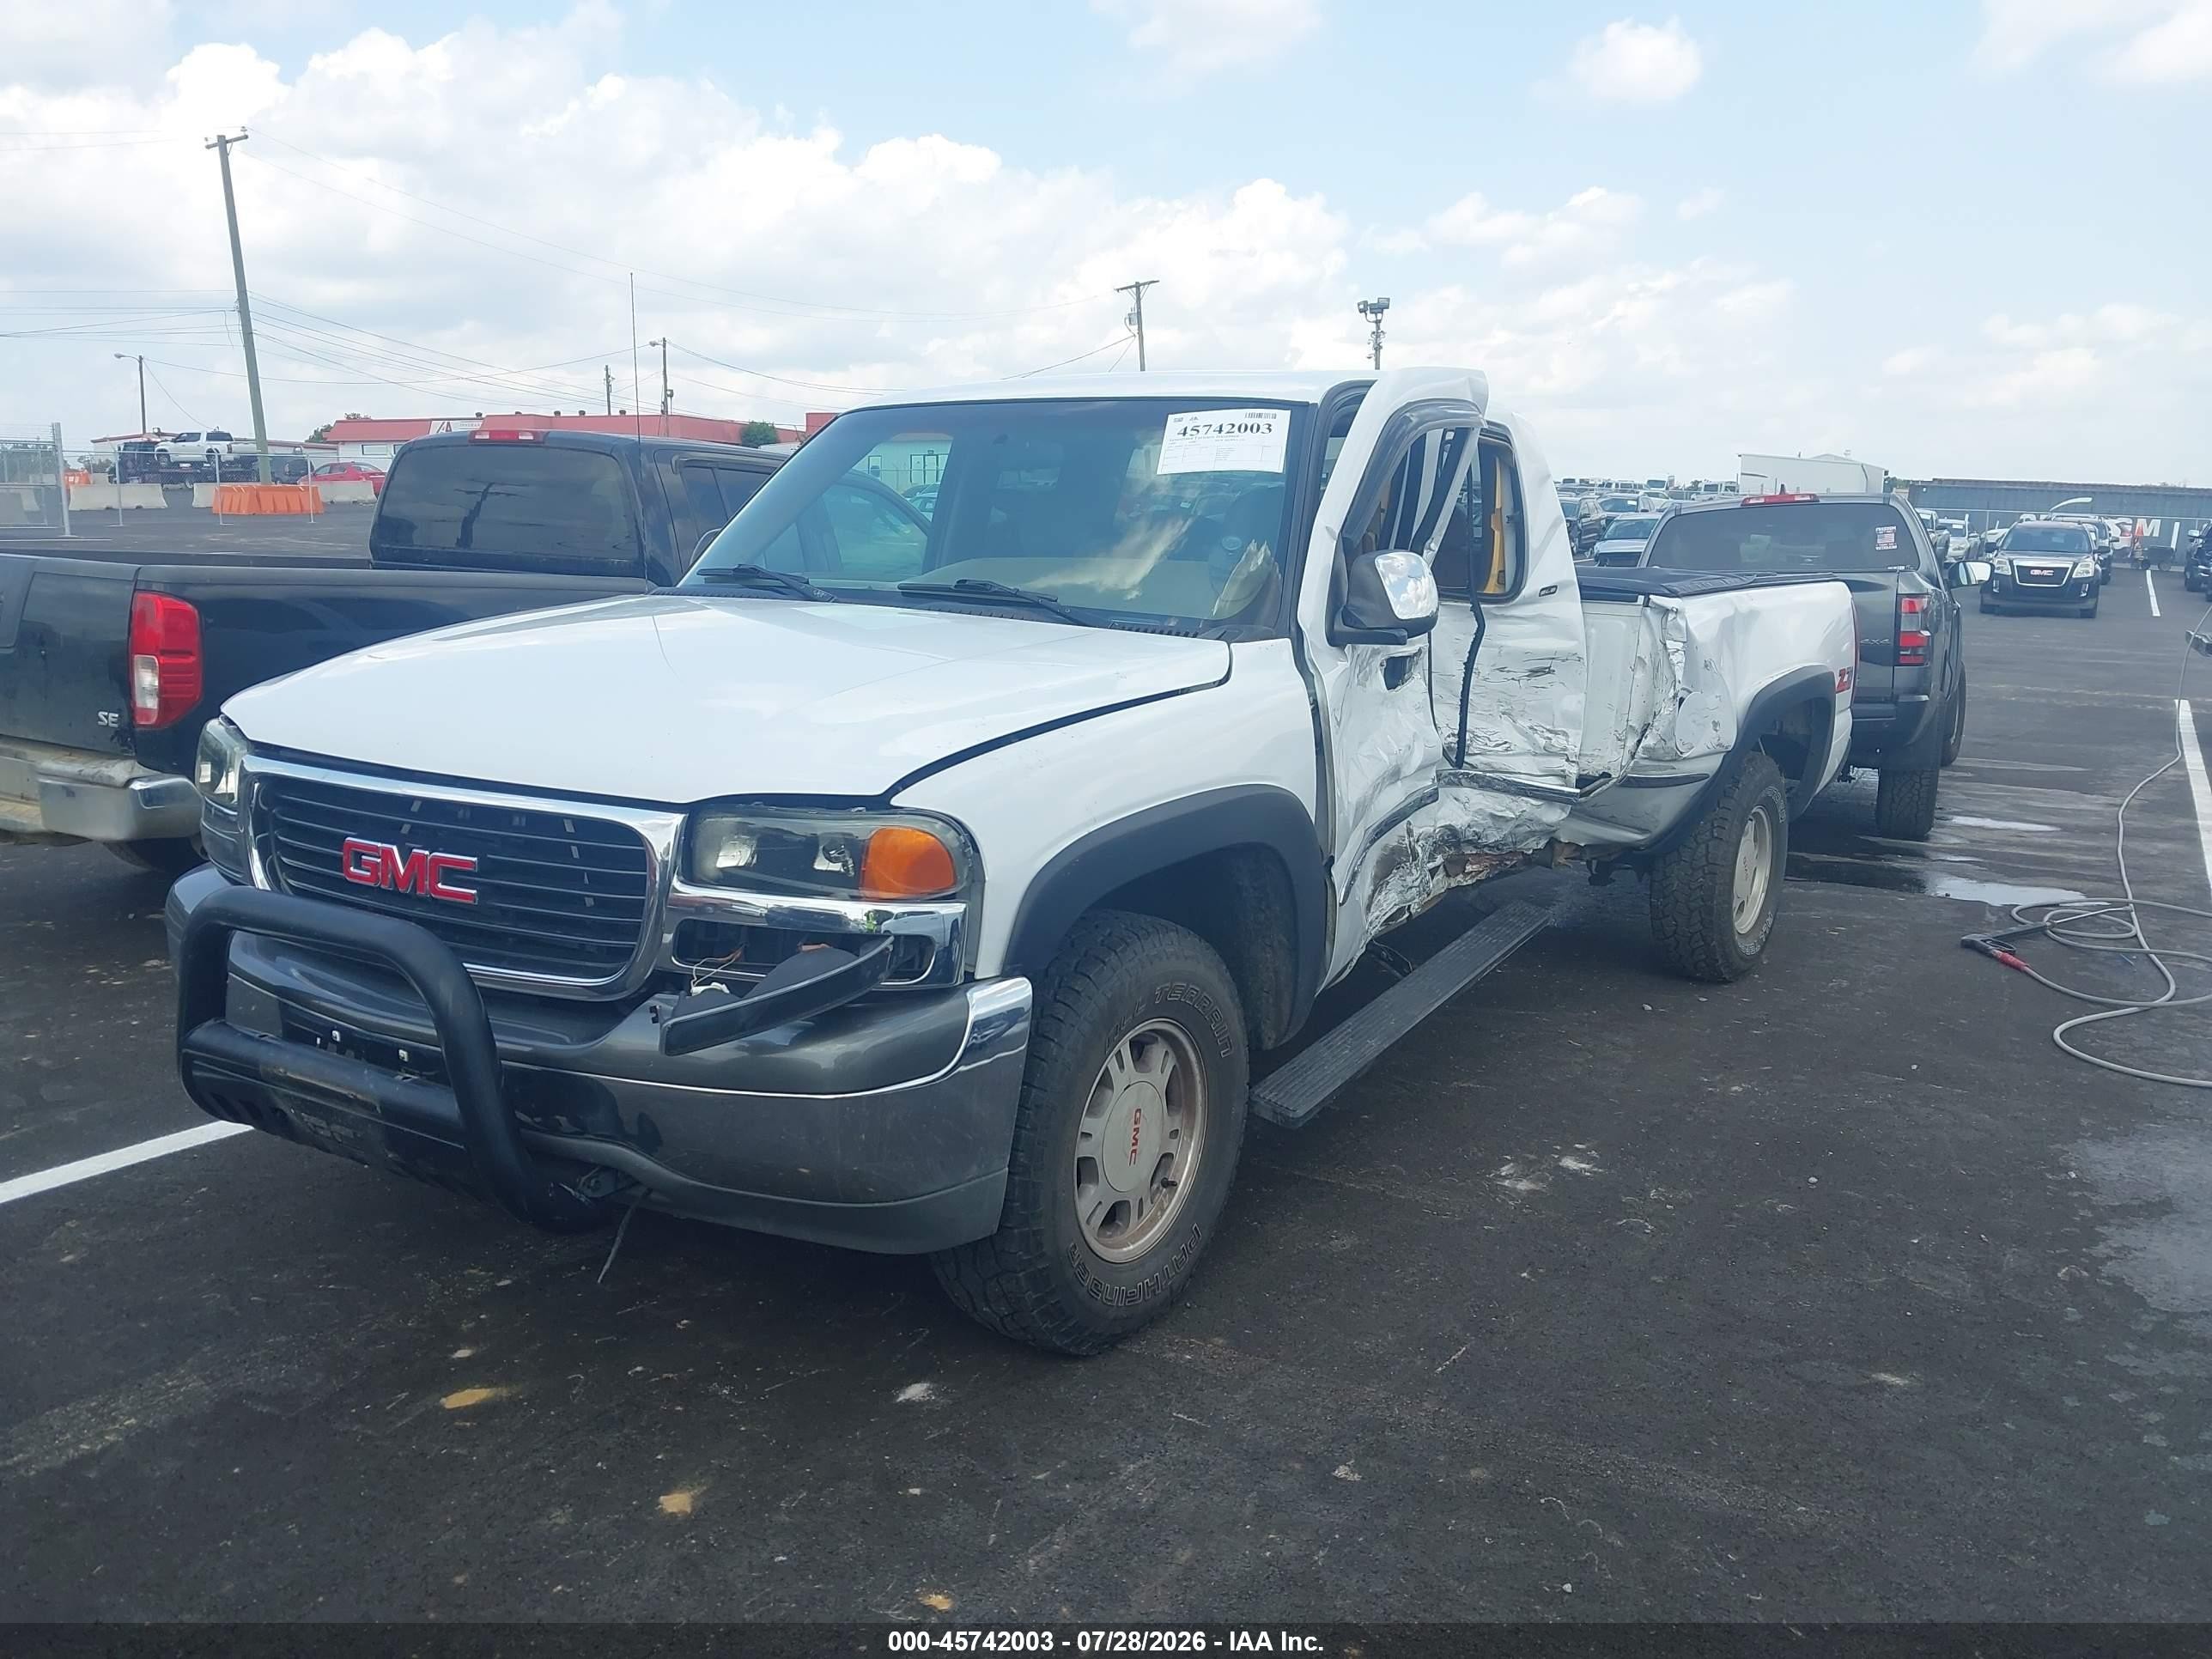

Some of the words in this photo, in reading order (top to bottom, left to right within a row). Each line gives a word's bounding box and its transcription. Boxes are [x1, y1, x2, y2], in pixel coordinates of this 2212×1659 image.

[1177, 422, 1273, 436] 45742003
[97, 710, 119, 728] SE
[343, 836, 478, 905] GMC
[1154, 982, 1235, 1060] TERRAIN
[1129, 1108, 1141, 1167] GMC
[1067, 1222, 1203, 1306] PATHFINDER
